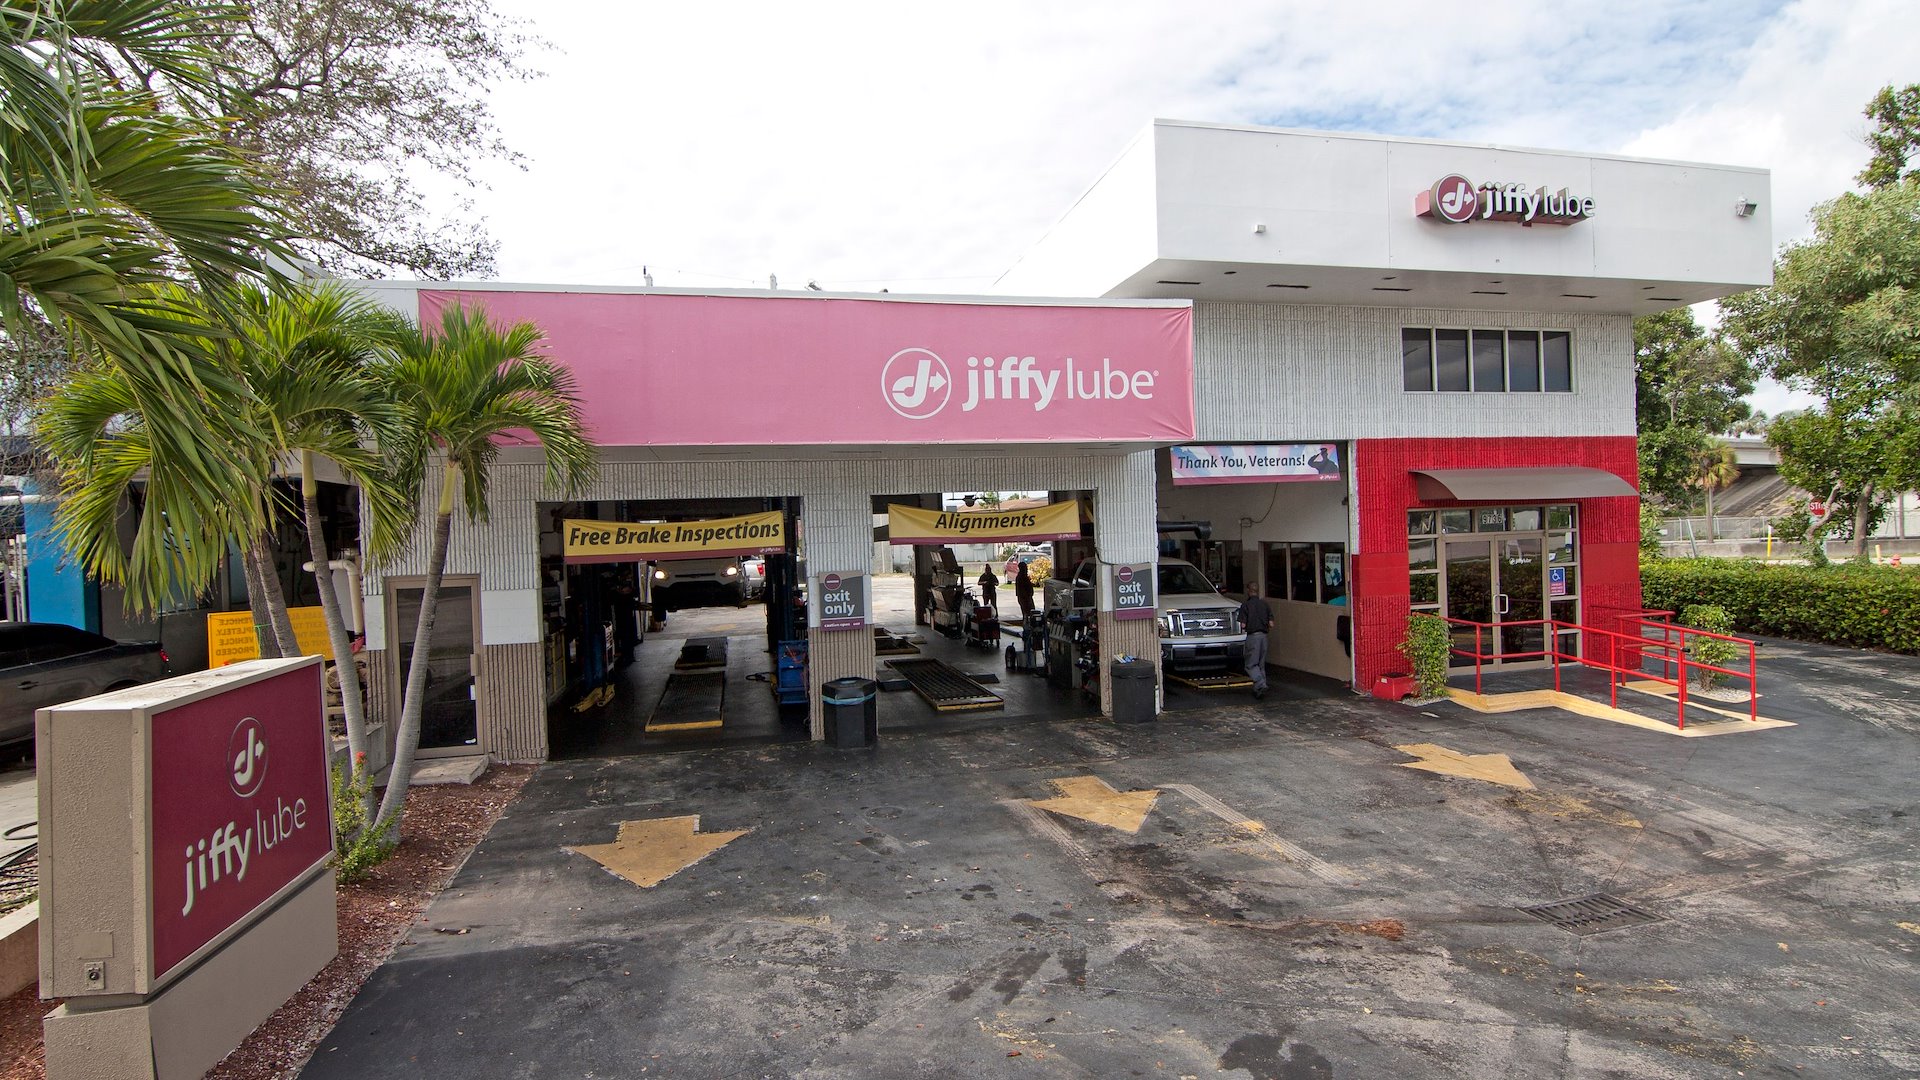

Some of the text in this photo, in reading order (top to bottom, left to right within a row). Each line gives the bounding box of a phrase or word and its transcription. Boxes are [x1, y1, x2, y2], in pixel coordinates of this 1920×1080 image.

[1483, 181, 1596, 221] jiffy lube
[962, 356, 1154, 411] jiffy lube
[1178, 454, 1305, 469] Thank You, Veterans!
[935, 513, 1036, 533] Alignments
[569, 521, 780, 546] Free Brake Inspections
[824, 589, 850, 602] exit
[1118, 581, 1142, 593] exit
[1119, 592, 1146, 606] only
[824, 601, 855, 616] only
[182, 797, 307, 917] jiffy lube
